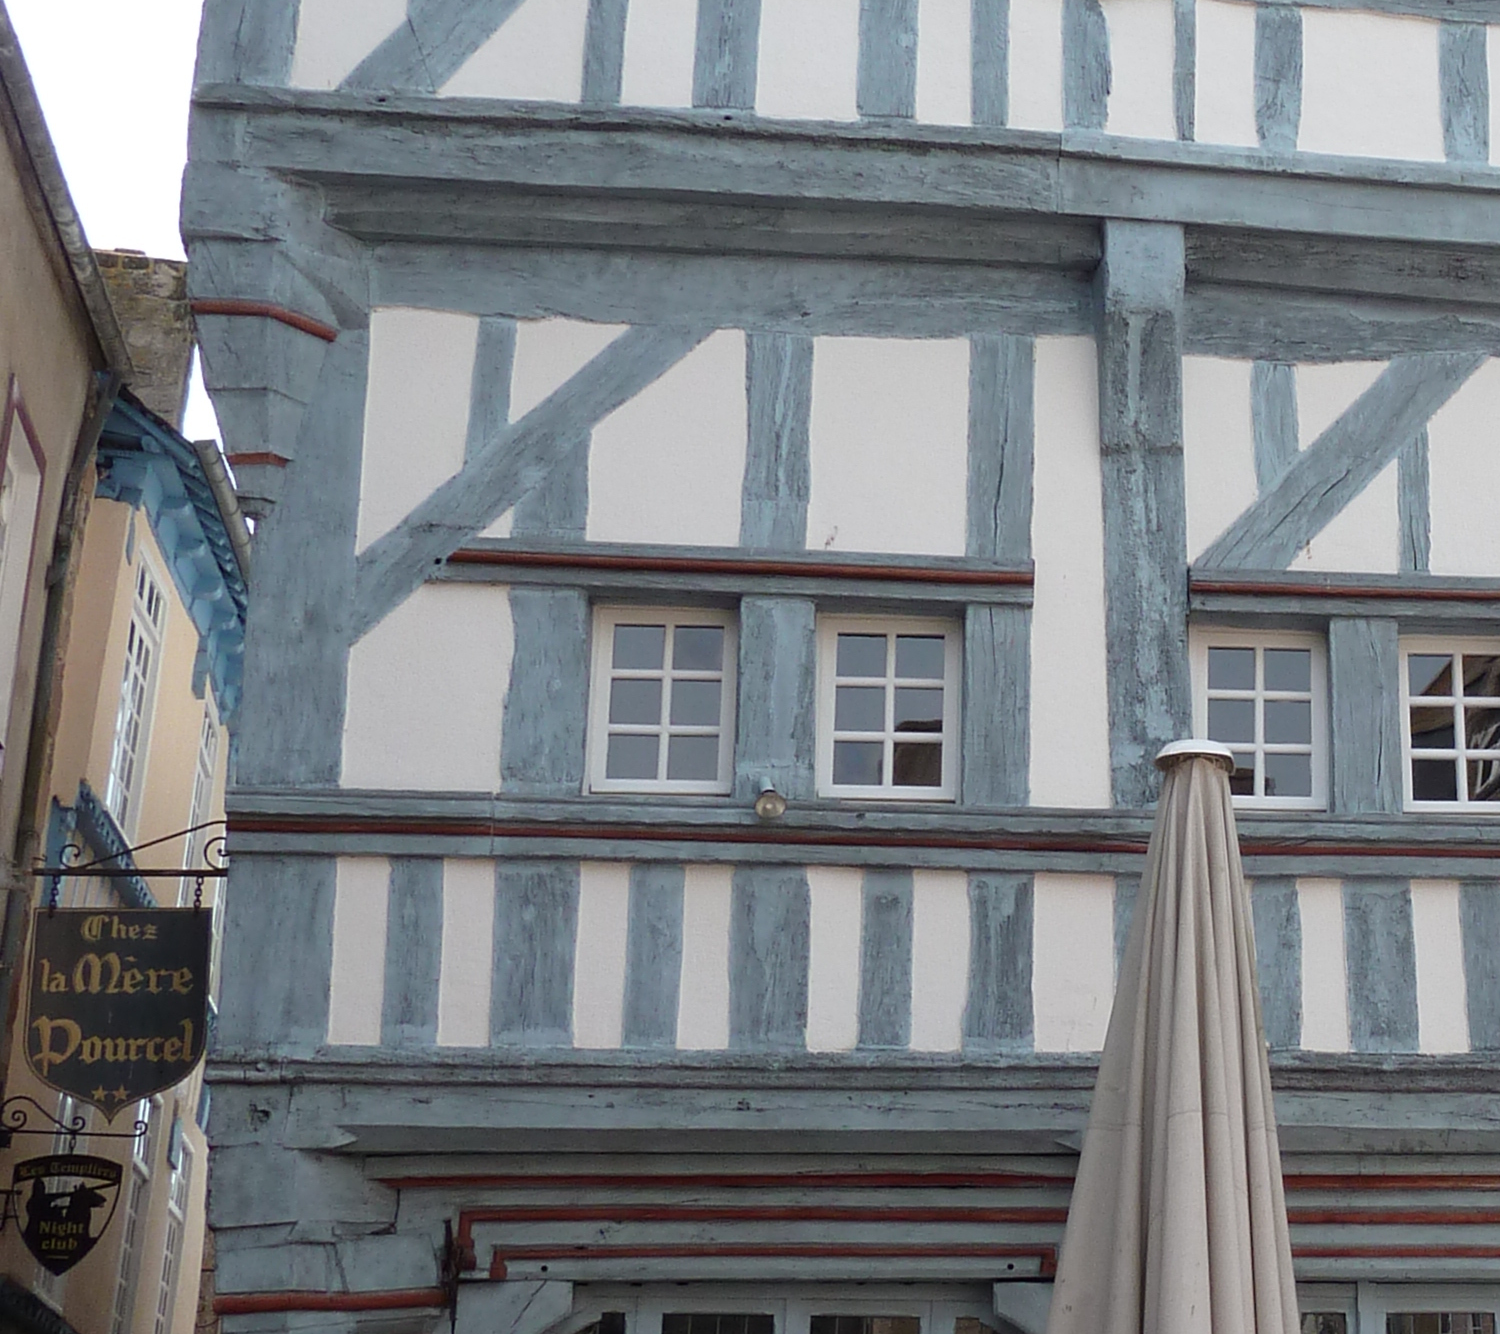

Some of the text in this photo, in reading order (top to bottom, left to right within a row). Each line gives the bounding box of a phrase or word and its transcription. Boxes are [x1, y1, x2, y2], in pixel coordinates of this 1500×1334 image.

[80, 915, 158, 941] Chez
[39, 952, 194, 994] la Mère
[32, 1015, 195, 1077] Pourcel
[50, 1162, 117, 1177] Templiers
[38, 1220, 84, 1236] Night
[41, 1237, 78, 1250] club
